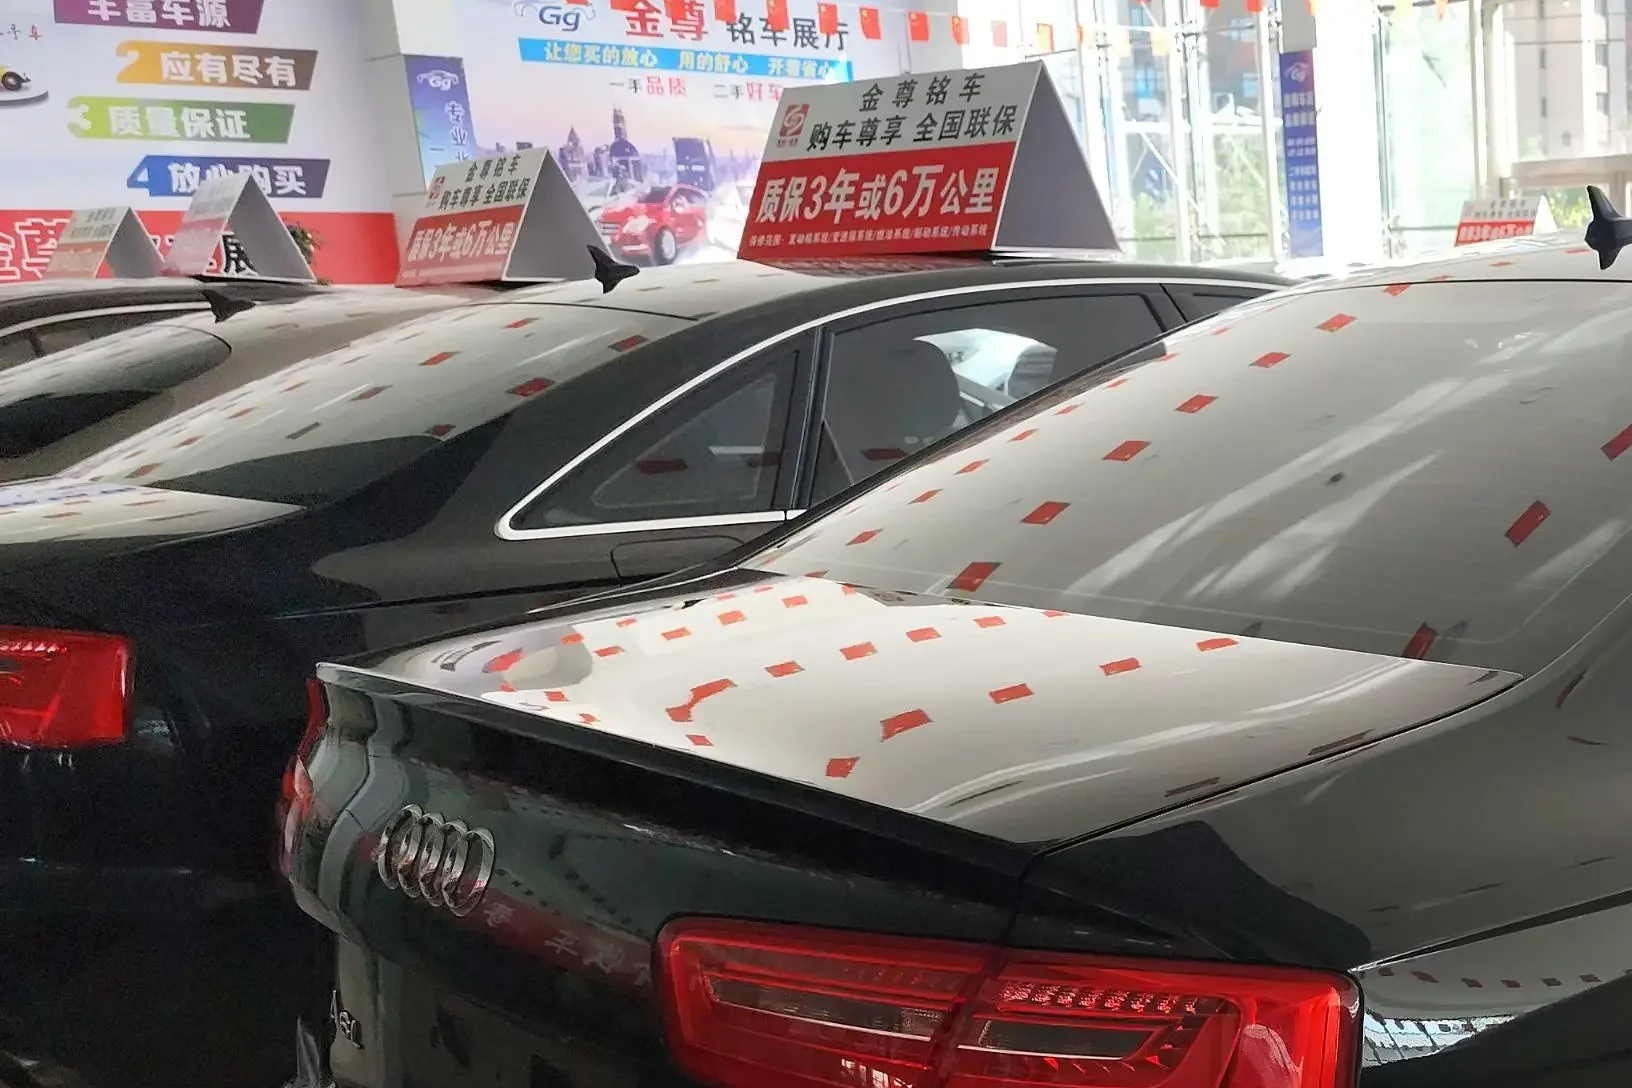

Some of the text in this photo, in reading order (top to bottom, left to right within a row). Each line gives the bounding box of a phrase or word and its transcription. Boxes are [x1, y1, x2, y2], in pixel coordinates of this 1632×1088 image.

[160, 51, 297, 88] 应有尽有
[678, 50, 749, 74] 用的舒心
[609, 75, 687, 97] 一手品质
[860, 74, 985, 112] 金尊铭车
[108, 105, 250, 139] 质量保证
[806, 104, 1018, 152] 购车尊享 全国联保
[755, 164, 999, 224] 质保3年或6万公里
